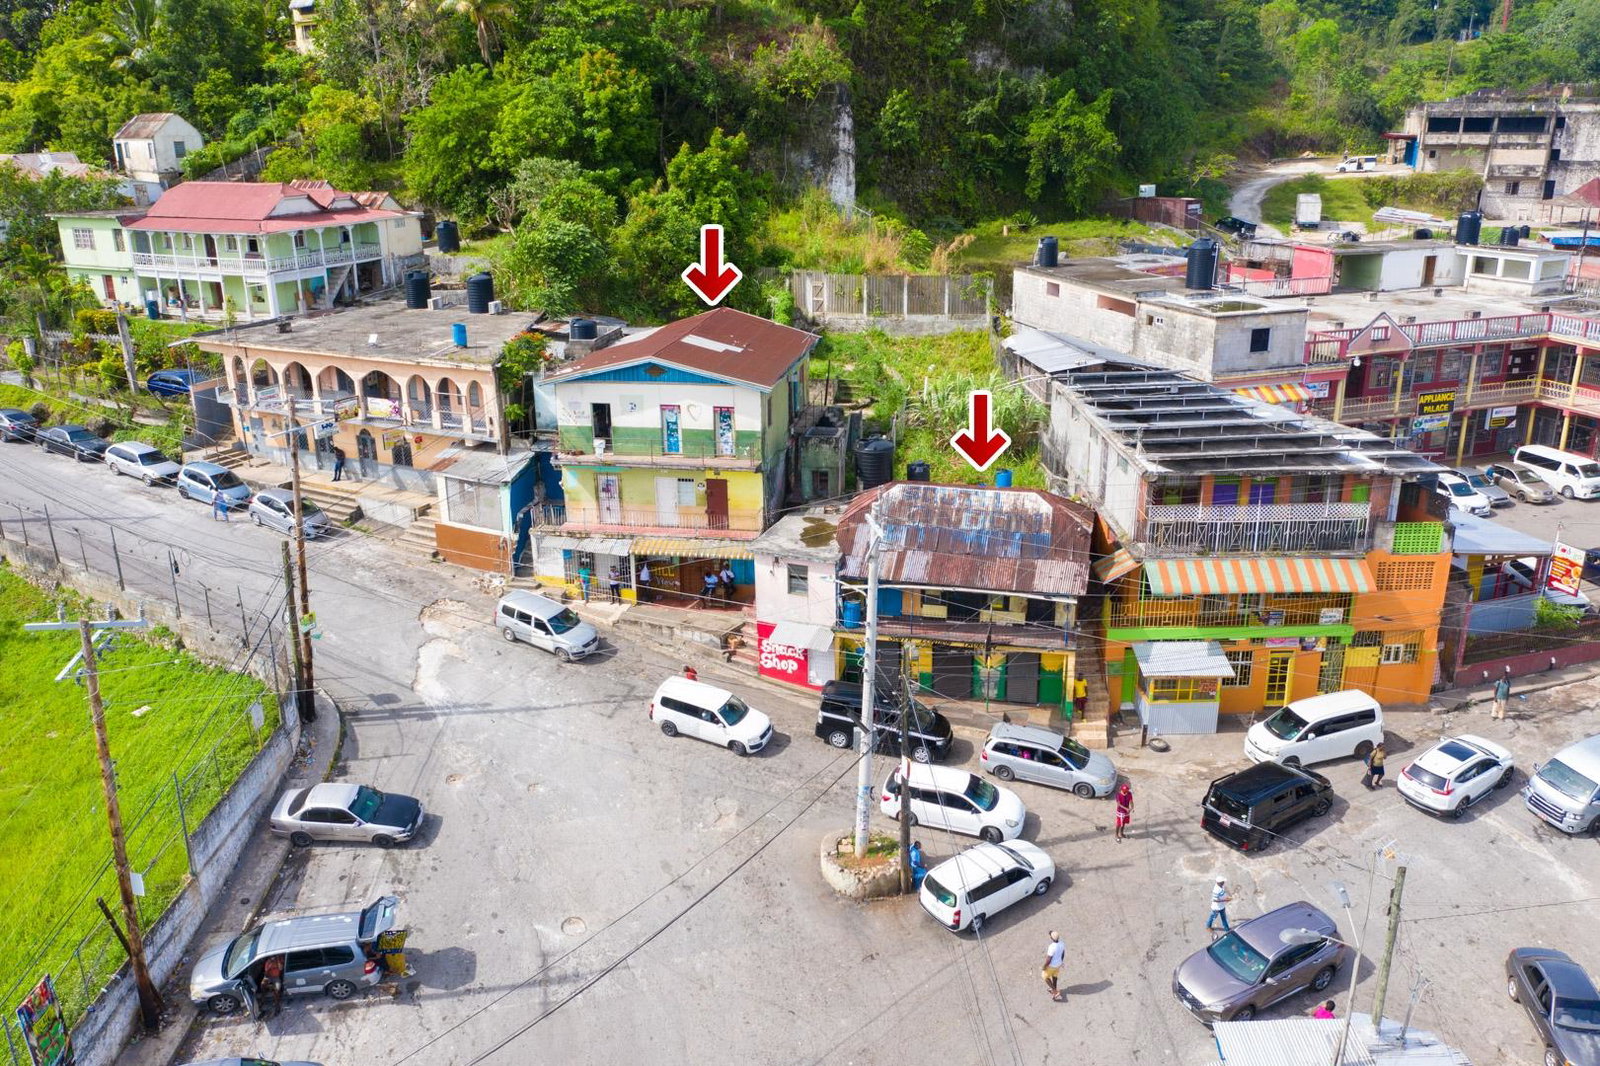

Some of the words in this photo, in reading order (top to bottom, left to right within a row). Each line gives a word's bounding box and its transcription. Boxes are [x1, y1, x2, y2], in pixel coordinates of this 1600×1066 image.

[1419, 392, 1455, 404] APPLIANCE
[1423, 404, 1449, 413] PALACE
[761, 639, 804, 660] Snack
[760, 652, 798, 673] Shop
